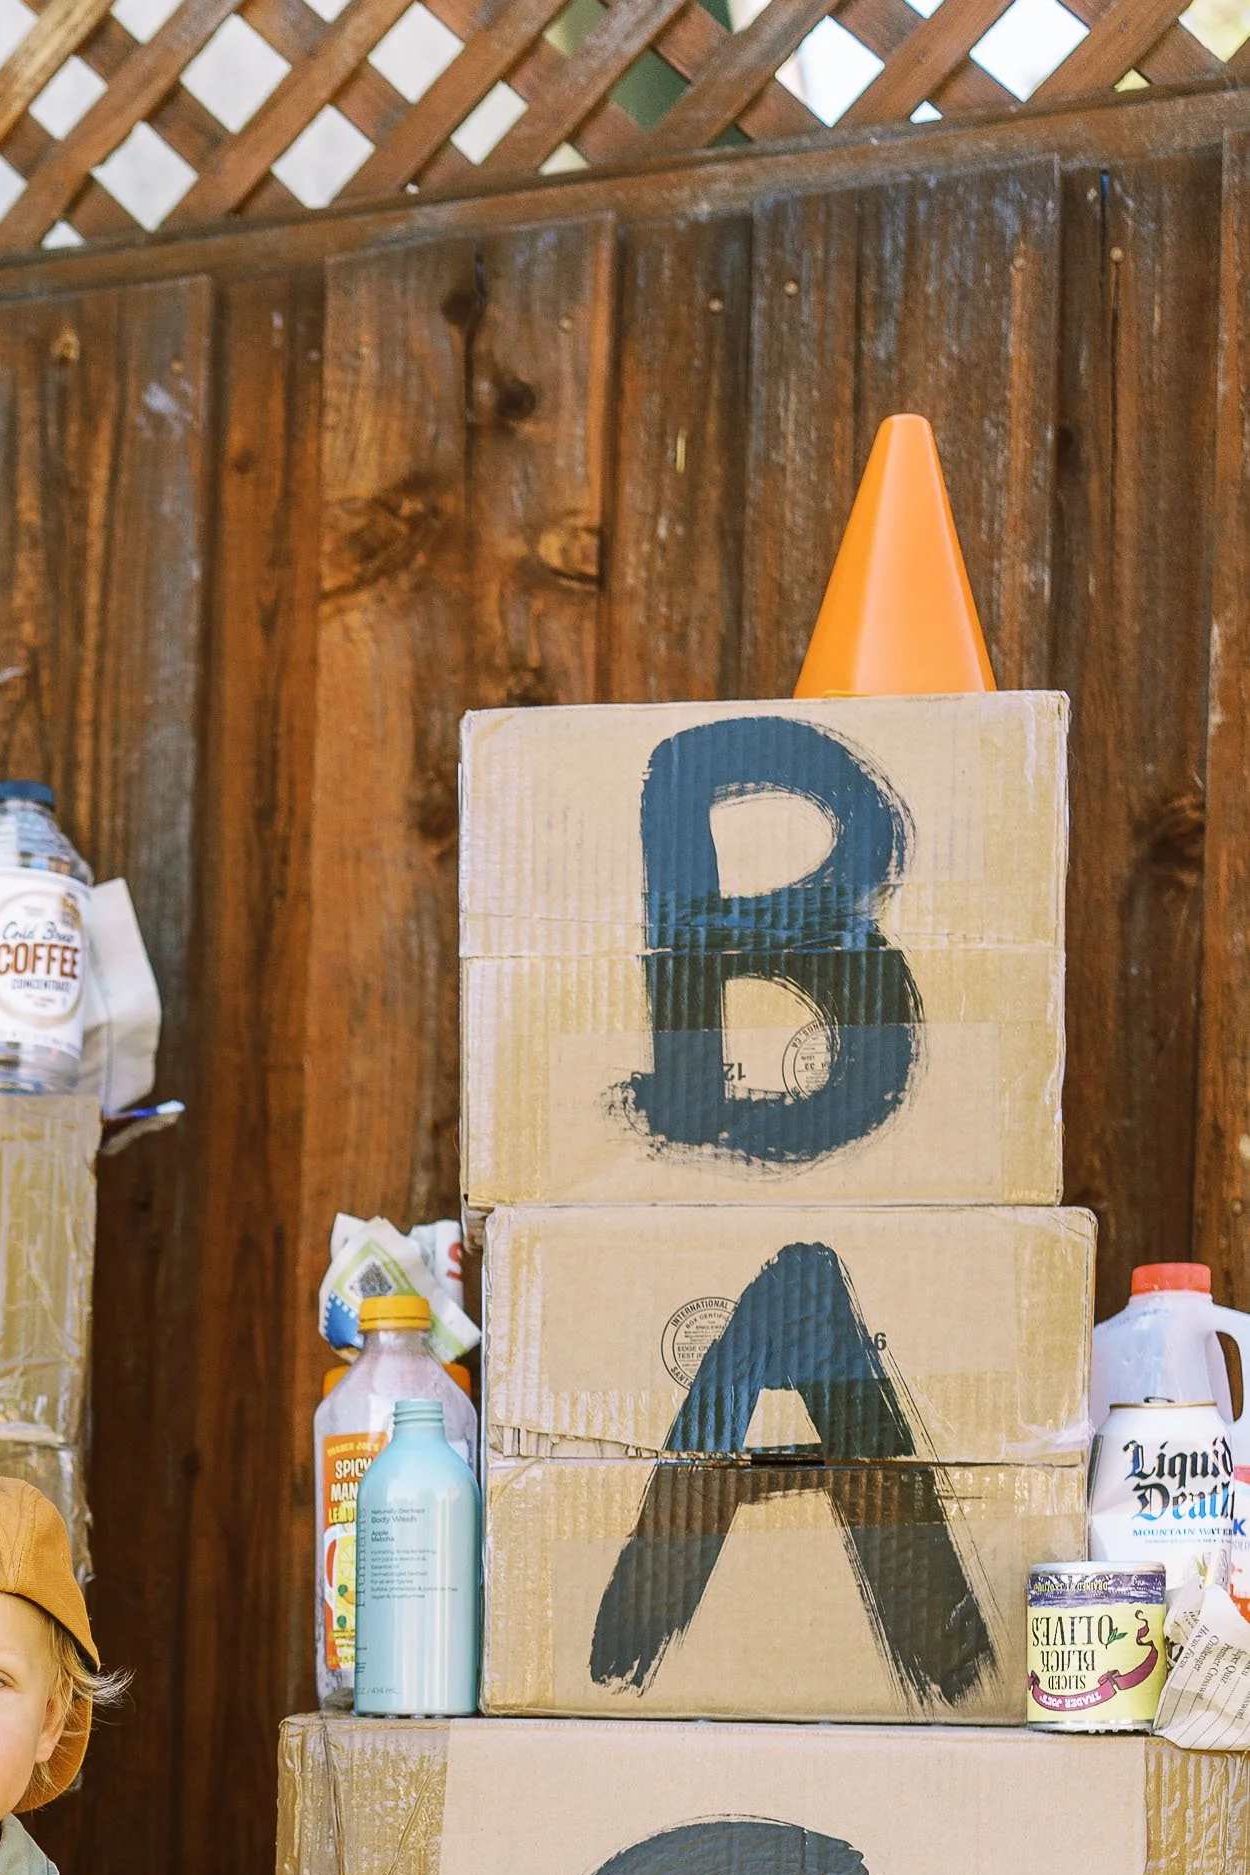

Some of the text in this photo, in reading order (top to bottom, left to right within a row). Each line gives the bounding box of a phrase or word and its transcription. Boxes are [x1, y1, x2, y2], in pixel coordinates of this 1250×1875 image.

[603, 716, 924, 1181] B
[671, 1299, 729, 1328] INTERNATIONAL
[588, 1240, 1005, 1712] A
[1123, 1436, 1233, 1490] Liquid
[1132, 1481, 1235, 1521] Death
[1133, 1528, 1195, 1536] MOUNTAIN
[1032, 1614, 1114, 1647] OLIVES
[1041, 1650, 1095, 1672] BLACK
[1194, 1635, 1219, 1673] Challenger
[1048, 1675, 1086, 1690] SLICED
[1221, 1665, 1237, 1684] Quiz
[1065, 1691, 1101, 1709] TRADER
